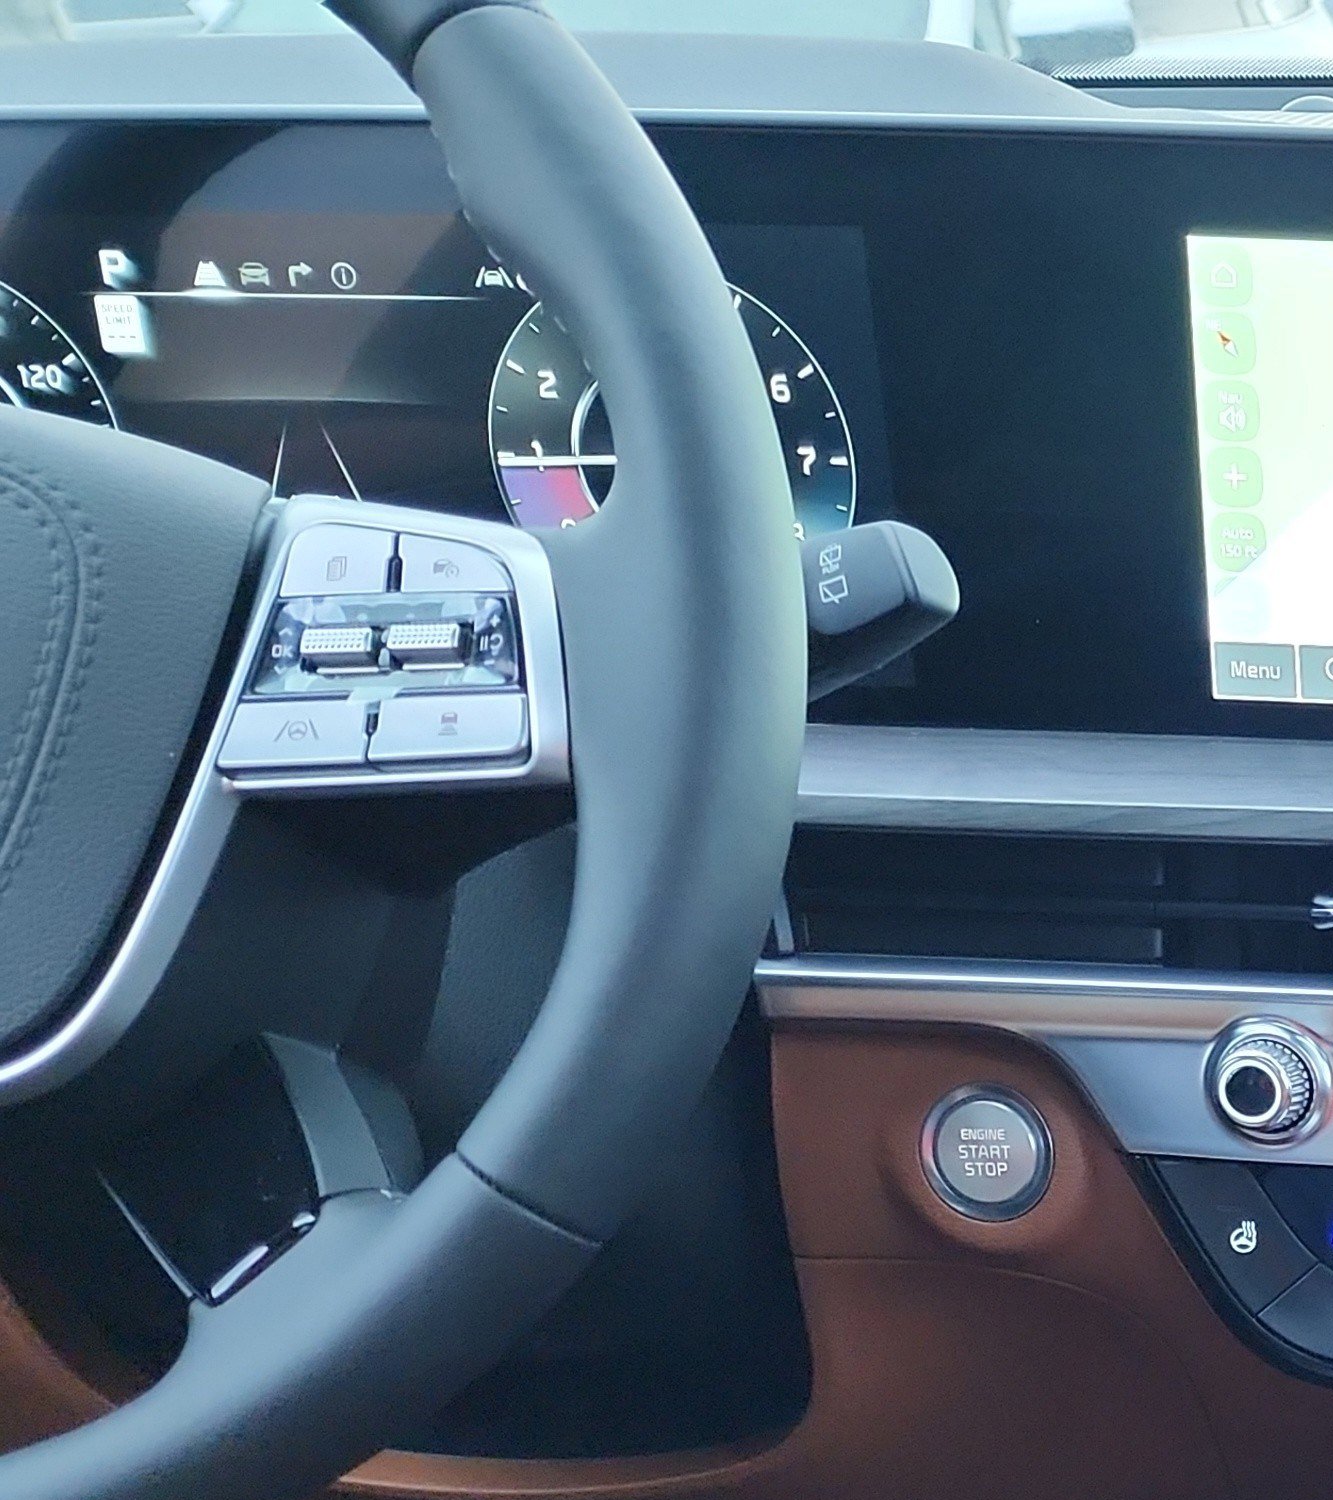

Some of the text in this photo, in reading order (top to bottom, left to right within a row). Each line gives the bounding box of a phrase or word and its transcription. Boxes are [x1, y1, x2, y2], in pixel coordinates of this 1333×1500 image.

[98, 249, 128, 289] P
[101, 304, 133, 313] SPEED
[106, 316, 132, 325] LIMIT
[16, 364, 62, 390] 120
[537, 370, 560, 399] 2
[770, 373, 791, 404] 6
[796, 445, 817, 476] 7
[271, 644, 294, 658] OK
[1230, 660, 1281, 680] Menu
[960, 1128, 1006, 1141] ENGINE
[958, 1145, 1011, 1159] START
[965, 1162, 1008, 1176] STOP
